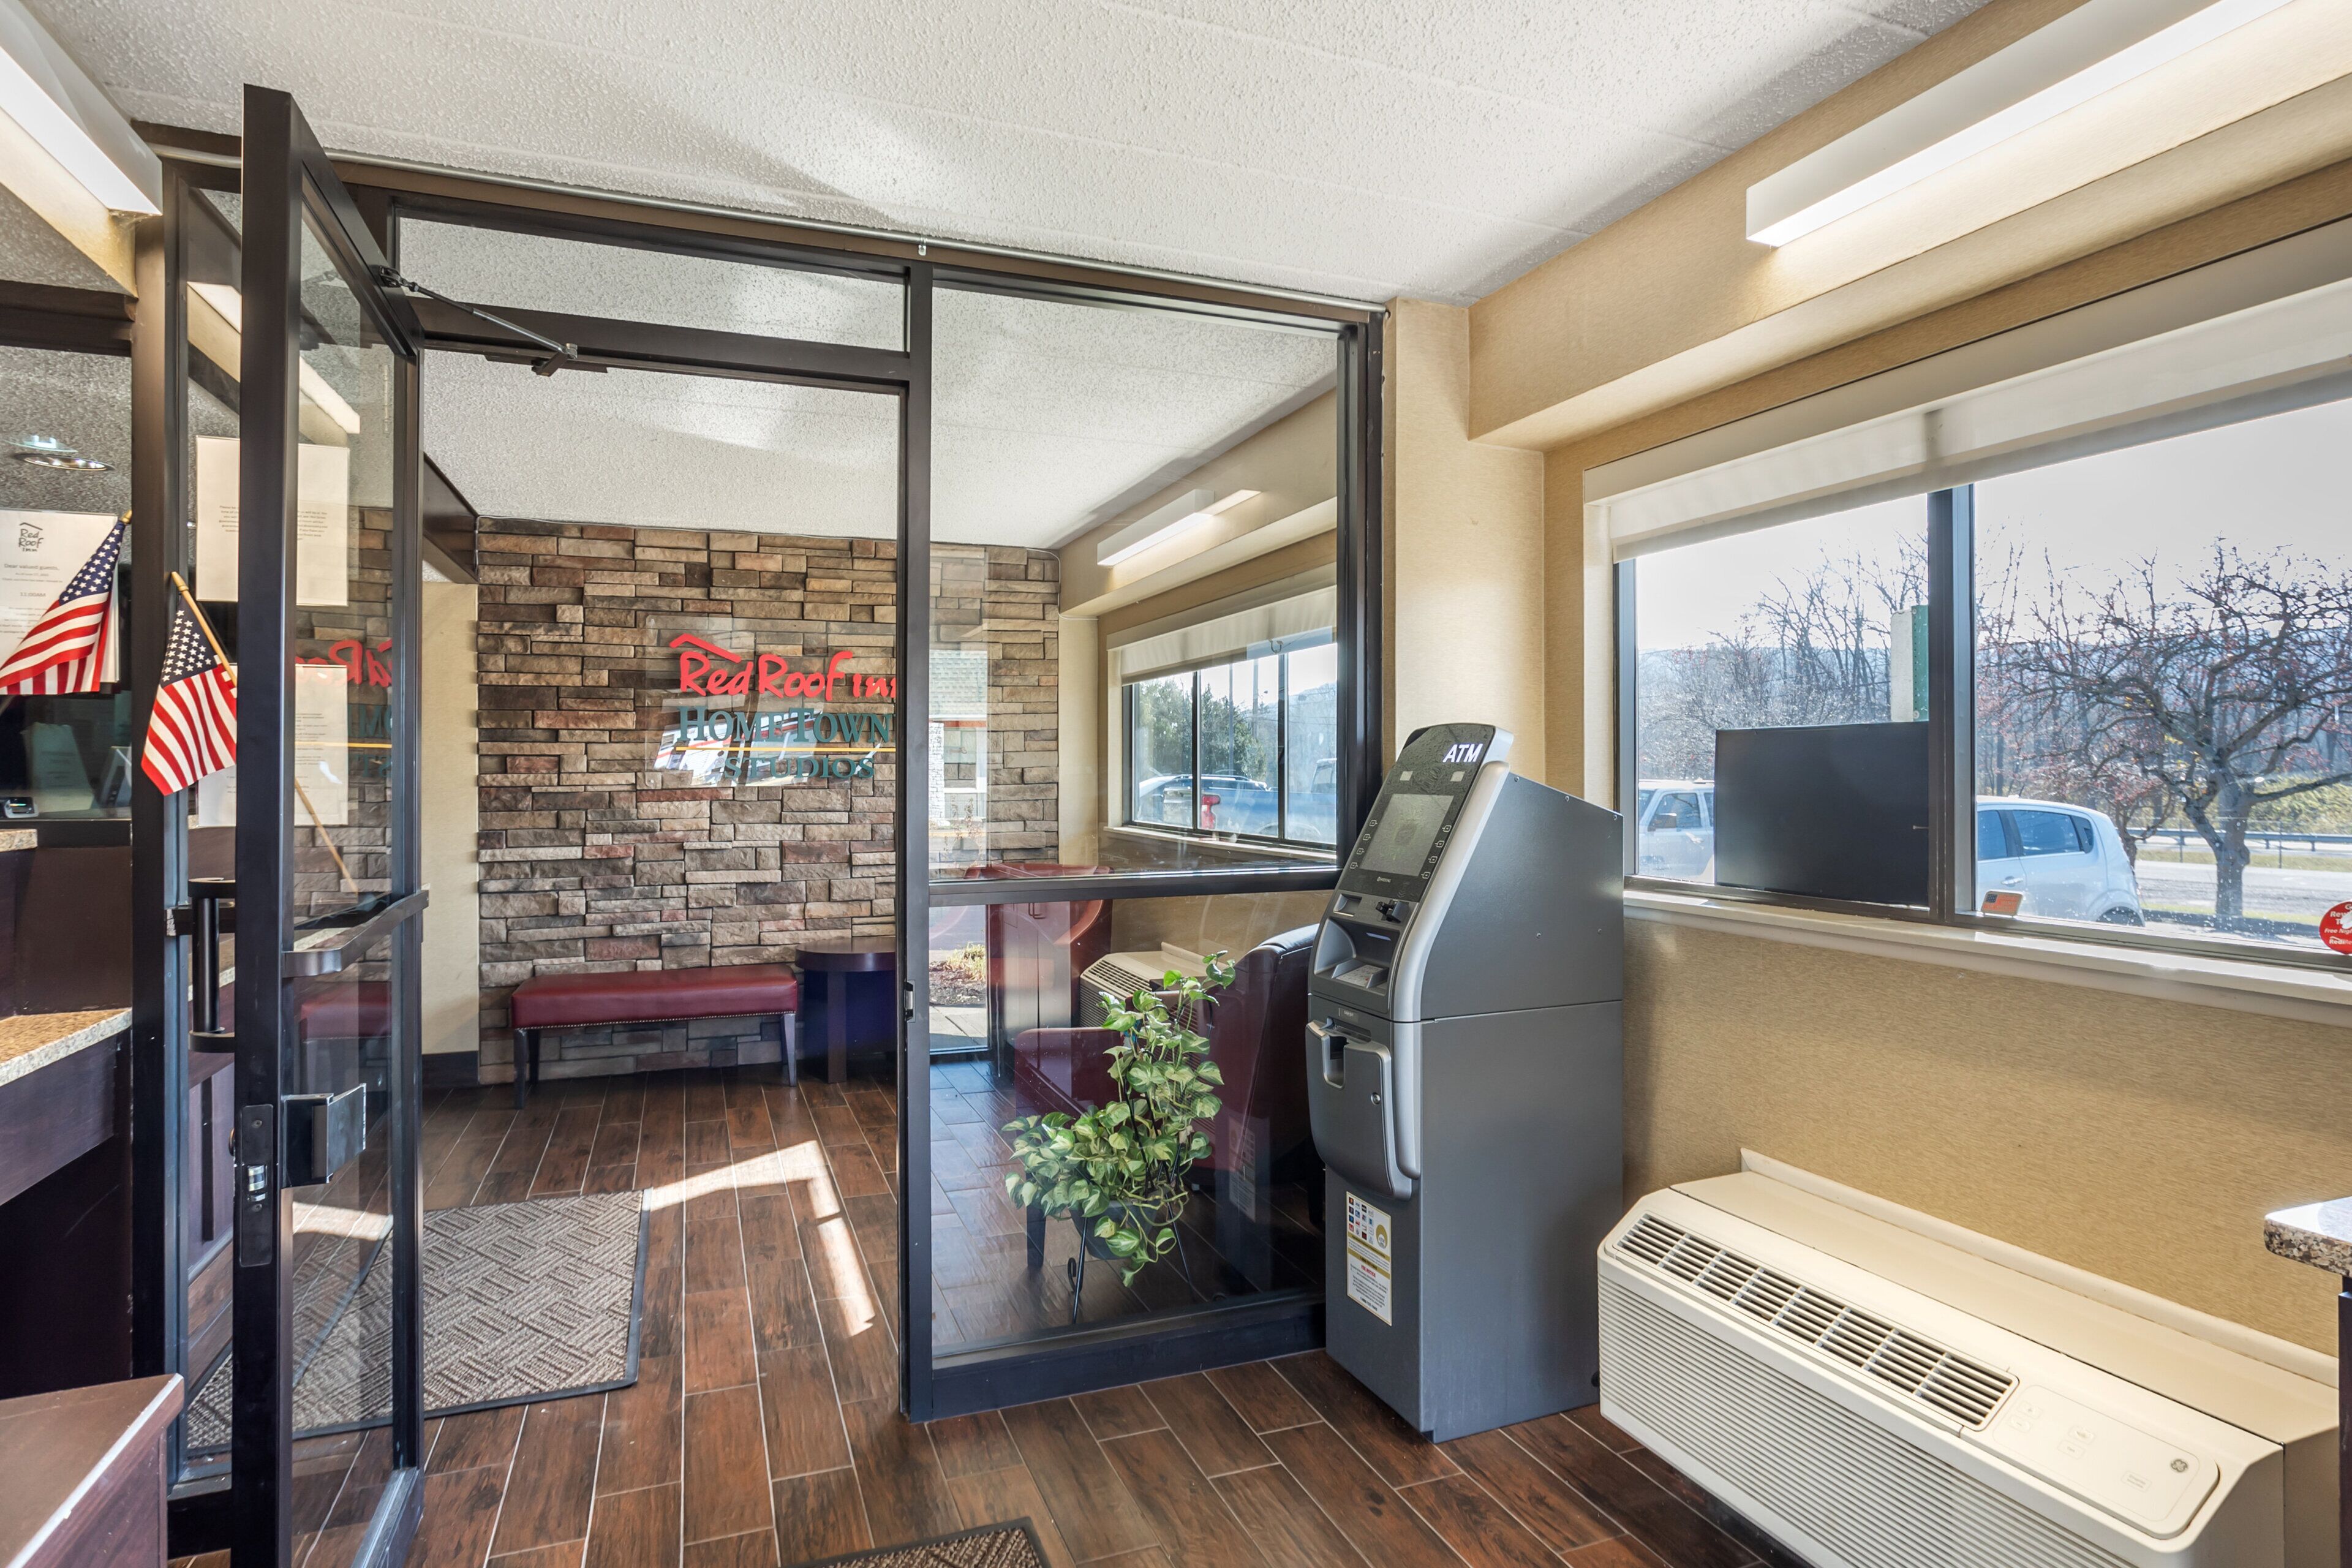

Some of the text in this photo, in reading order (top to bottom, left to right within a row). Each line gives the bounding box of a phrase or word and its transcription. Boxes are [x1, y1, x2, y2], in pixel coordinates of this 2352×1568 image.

[18, 537, 44, 548] Roof
[20, 529, 40, 538] Red
[853, 673, 896, 698] in
[676, 706, 895, 744] HOMETOWN
[1442, 743, 1484, 763] ATM
[725, 756, 875, 779] STUDIOS
